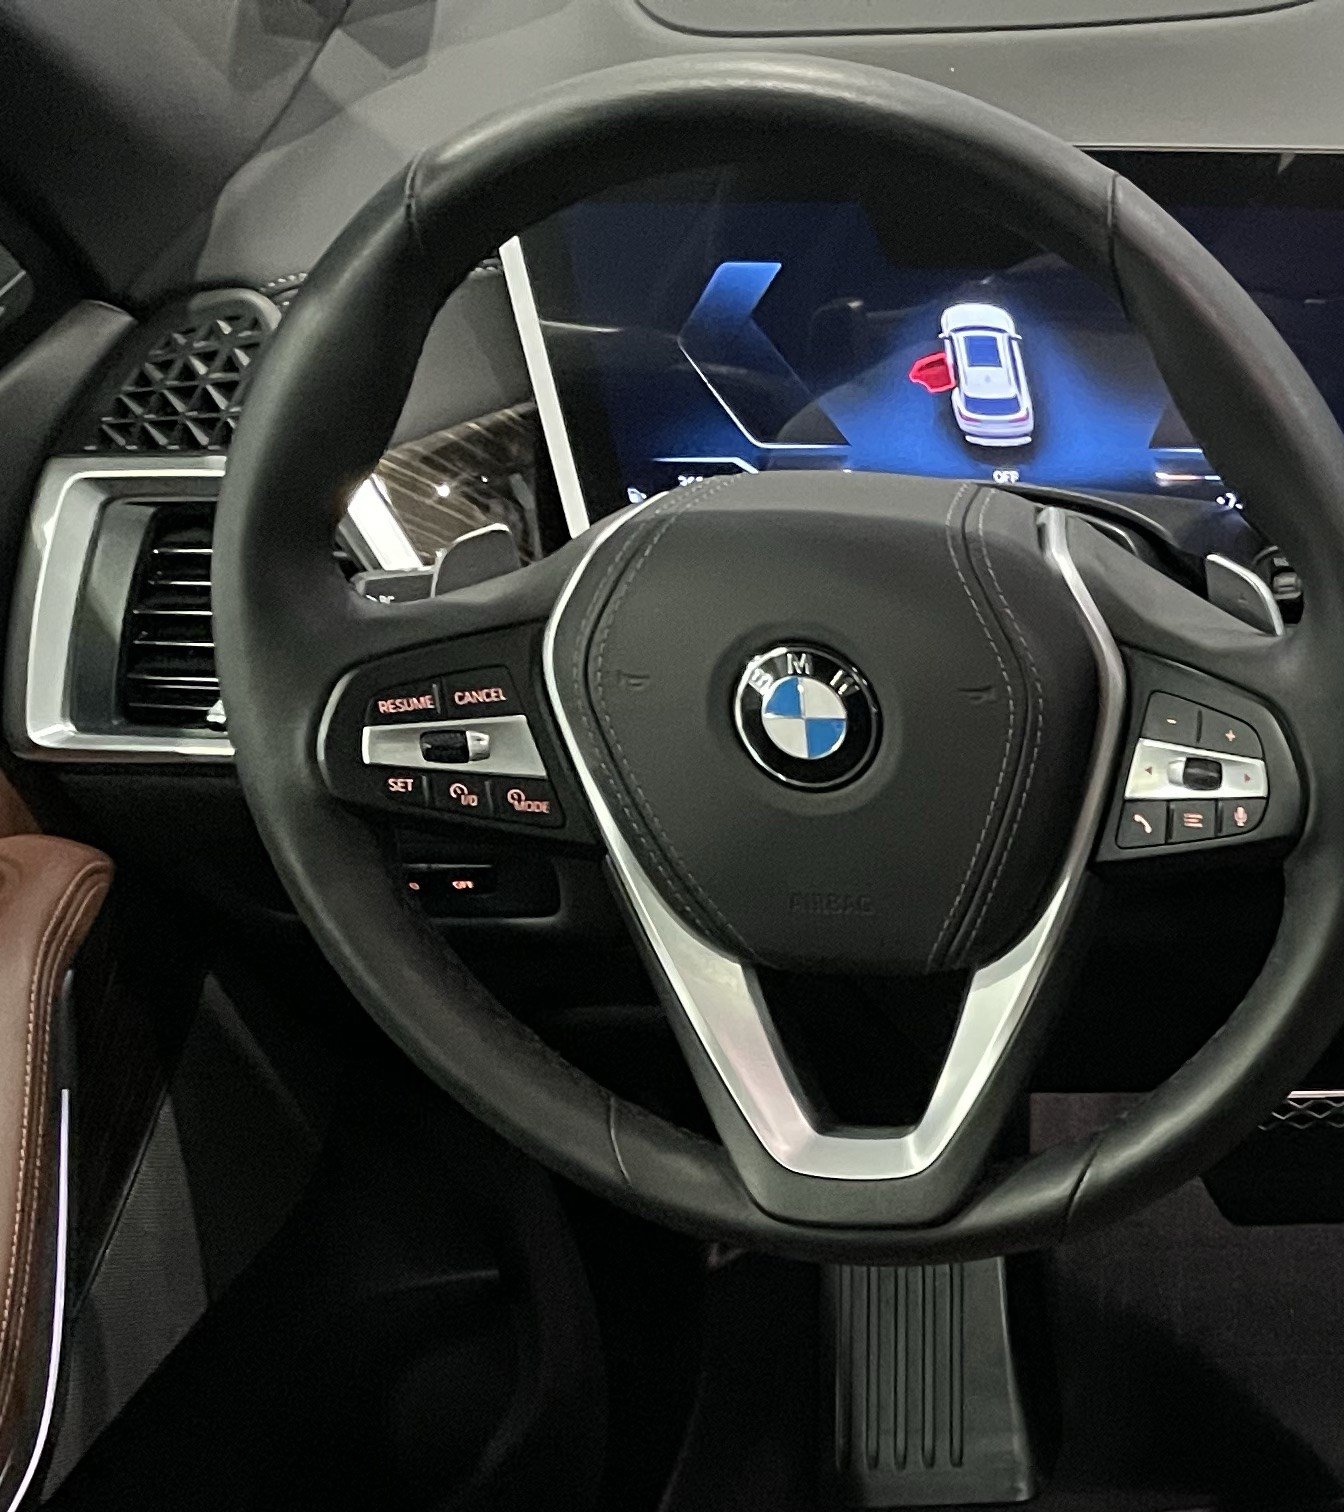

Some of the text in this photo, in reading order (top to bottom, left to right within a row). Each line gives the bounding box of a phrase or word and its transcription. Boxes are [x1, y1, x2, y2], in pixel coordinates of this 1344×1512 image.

[748, 653, 860, 697] BMW
[378, 695, 435, 714] RESUME
[454, 688, 506, 705] CANCEL
[388, 778, 414, 792] SET
